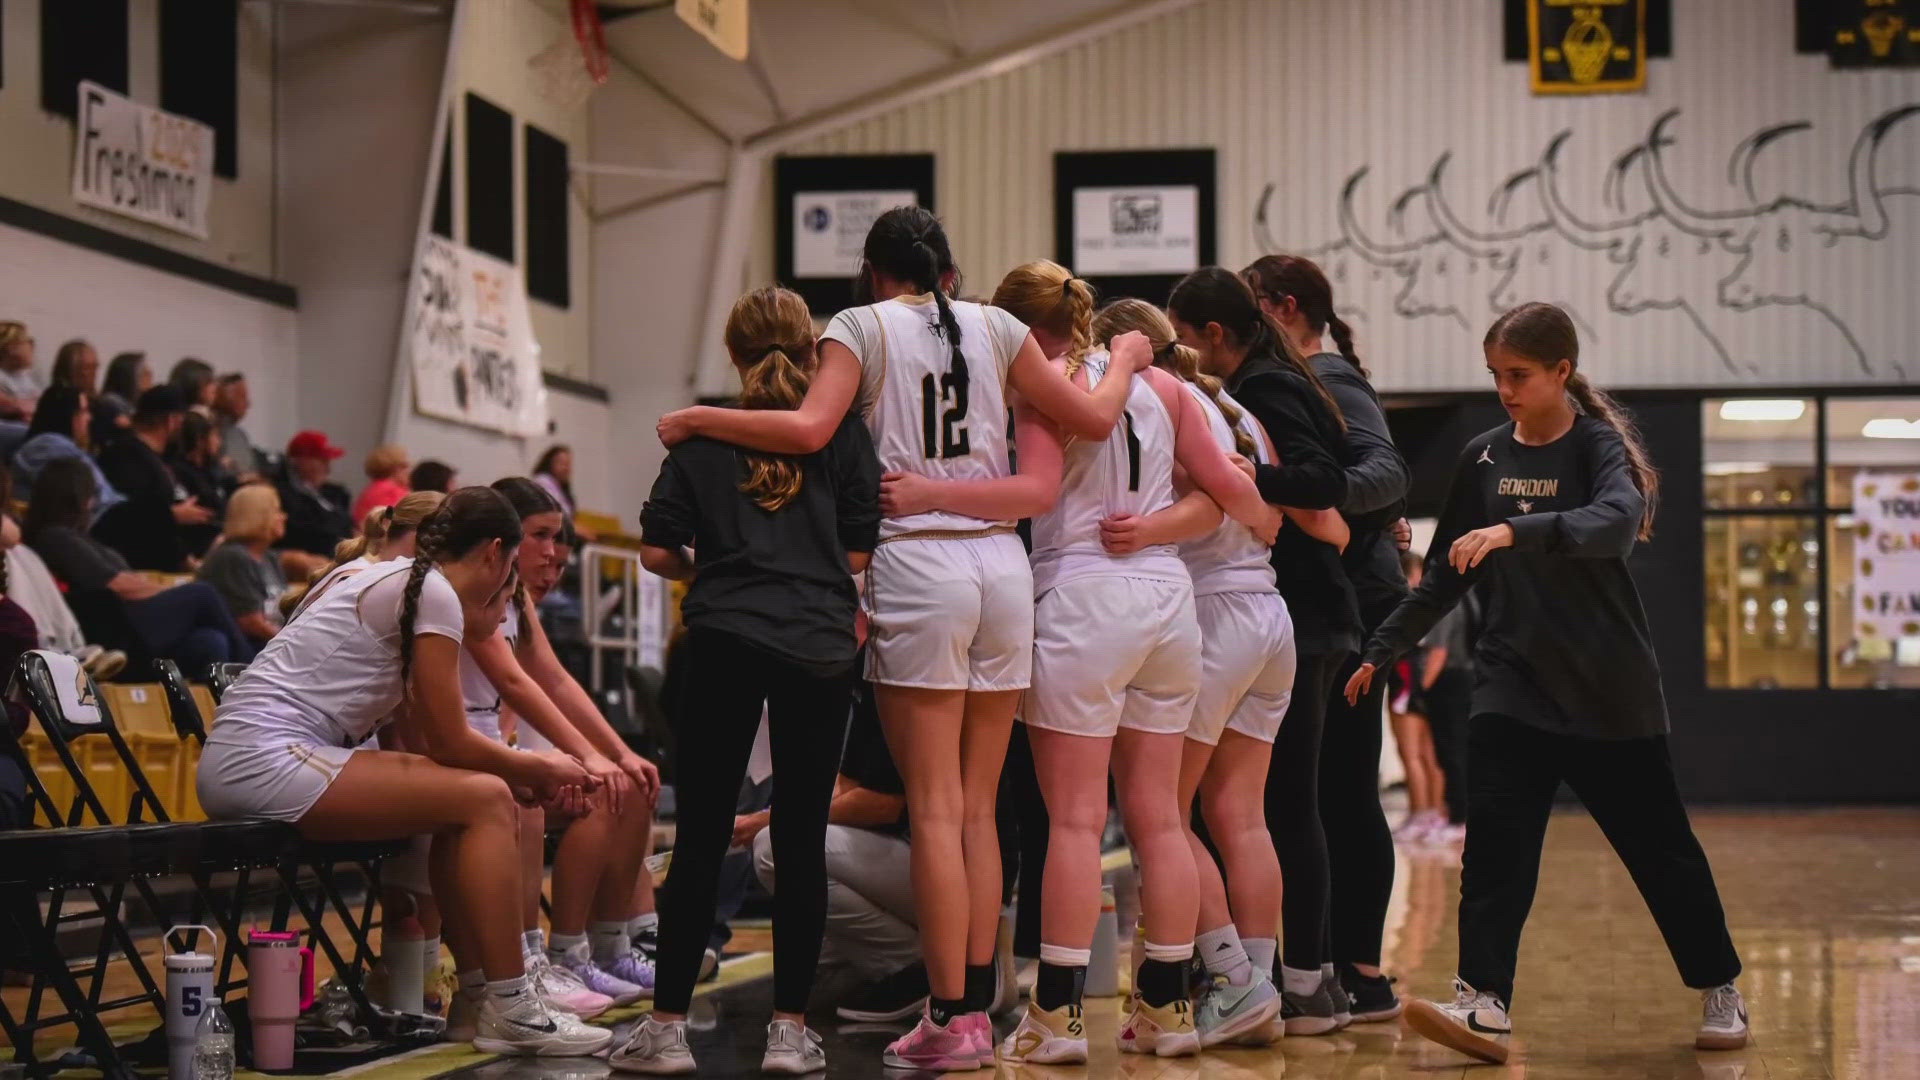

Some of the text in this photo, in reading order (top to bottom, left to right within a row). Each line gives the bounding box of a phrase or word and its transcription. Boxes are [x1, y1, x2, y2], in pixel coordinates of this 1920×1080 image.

[922, 372, 970, 459] 12
[1498, 477, 1558, 497] GORDON
[182, 986, 201, 1017] 5
